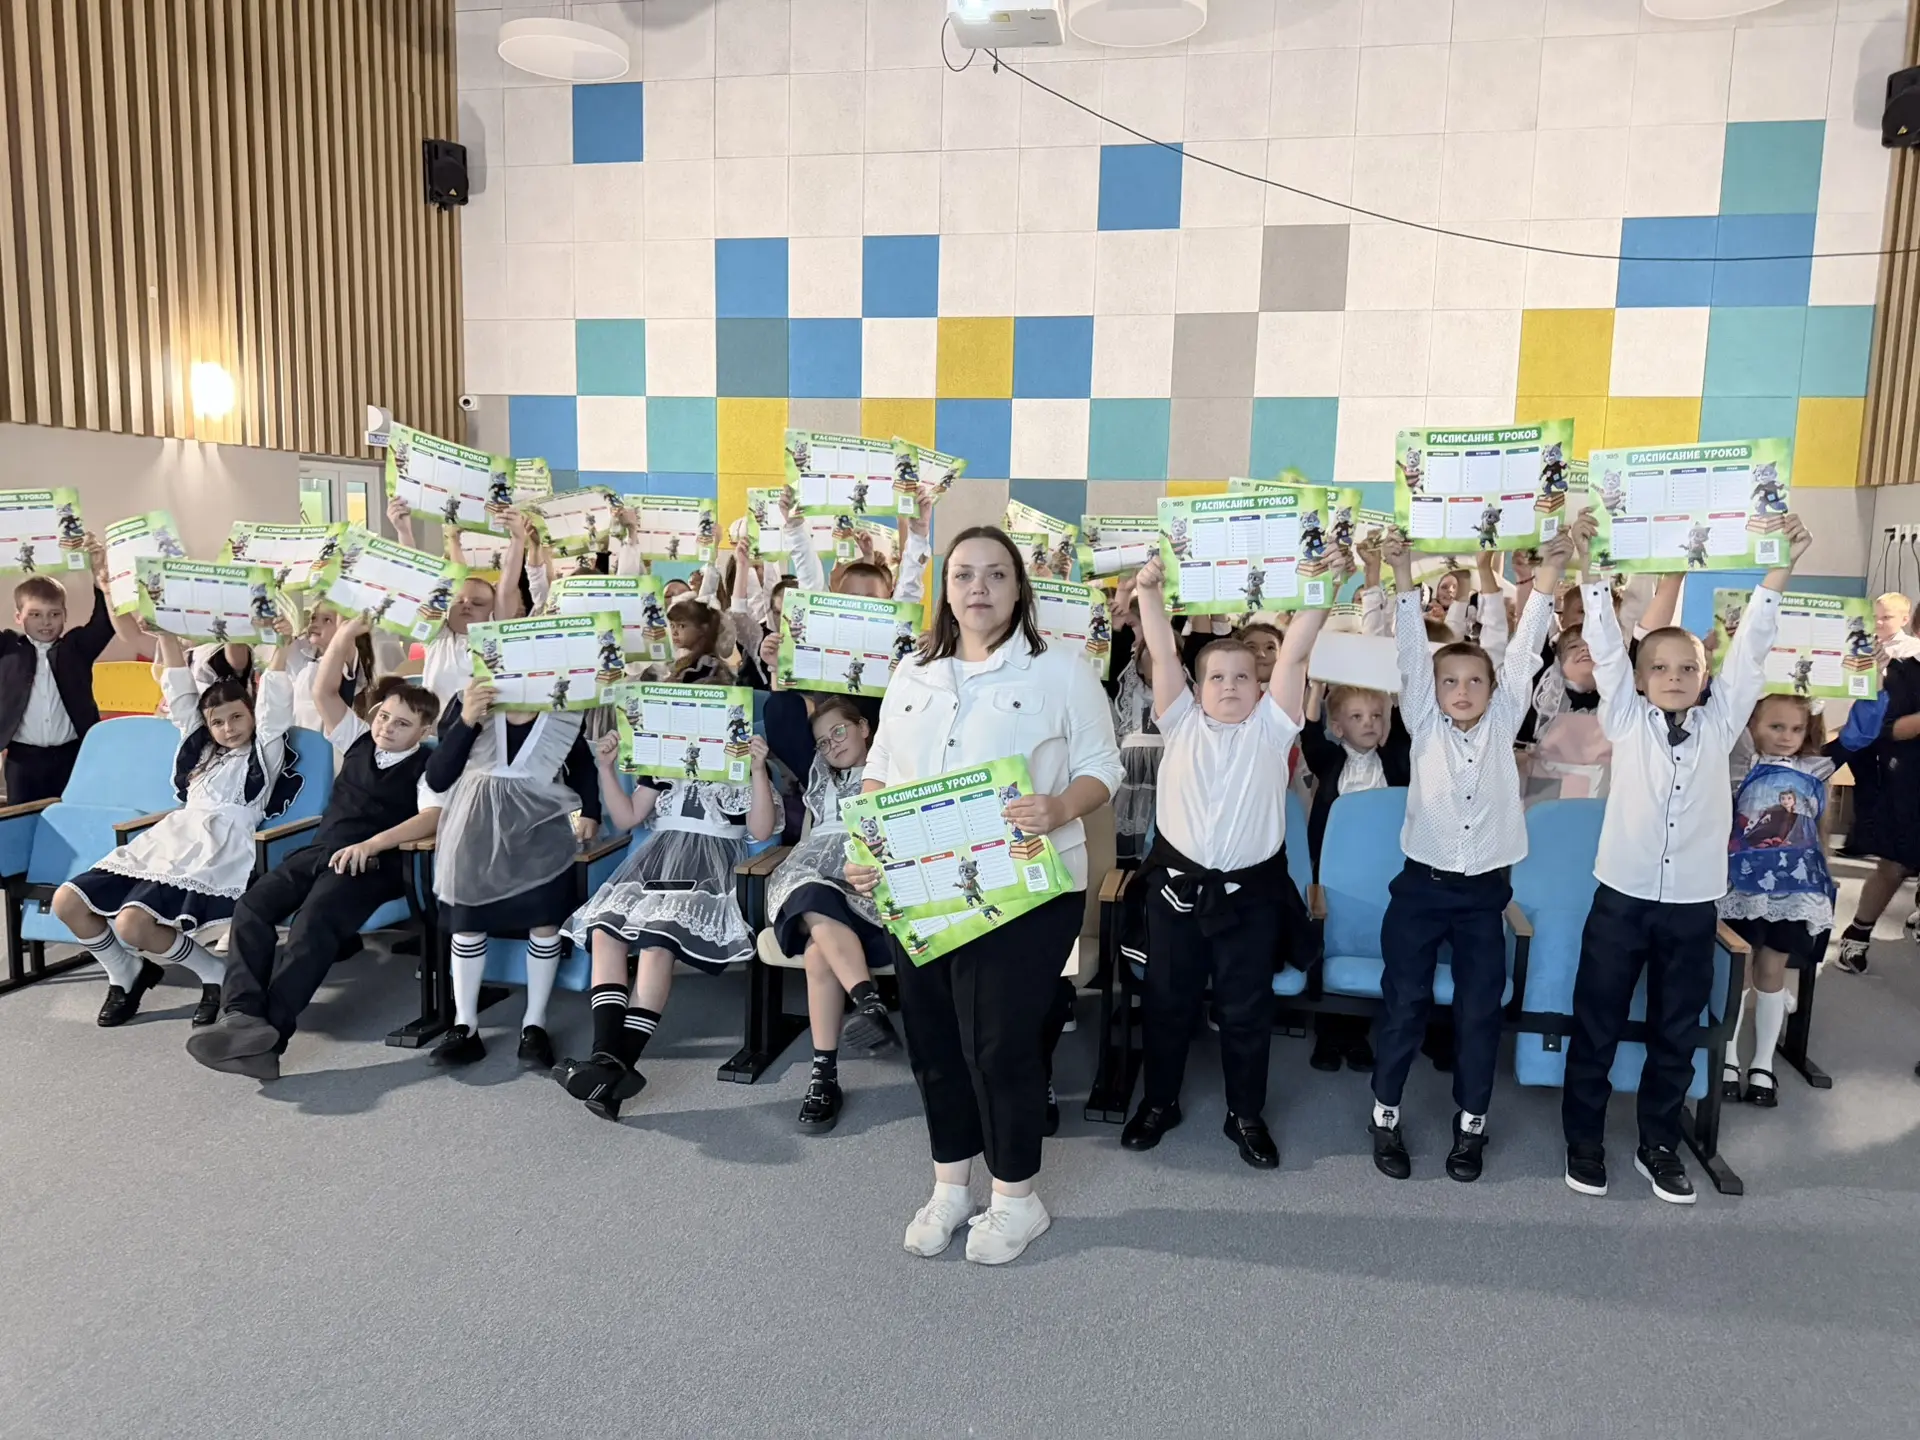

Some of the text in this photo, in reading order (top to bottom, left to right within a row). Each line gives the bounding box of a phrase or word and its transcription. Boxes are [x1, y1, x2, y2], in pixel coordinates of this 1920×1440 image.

[1430, 432, 1494, 444] РАСПИСАНИЕ
[1498, 429, 1538, 441] УРОКОВ
[415, 435, 489, 464] РАСПИСАНИЕ УРОКОВ
[1631, 450, 1700, 463] РАСПИСАНИЕ
[1704, 447, 1747, 459] УРОКОВ
[1195, 496, 1295, 511] РАСПИСАНИЕ УРОКОВ
[1061, 585, 1088, 595] УРОКОВ
[813, 597, 894, 613] РАСПИСАНИЕ УРОКОВ
[1807, 599, 1842, 609] УРОКОВ
[502, 618, 592, 633] РАСПИСАНИЕ УРОКОВ
[644, 687, 725, 698] РАСПИСАНИЕ УРОКОВ
[880, 771, 988, 807] РАСПИСАНИЕ УРОКОВ
